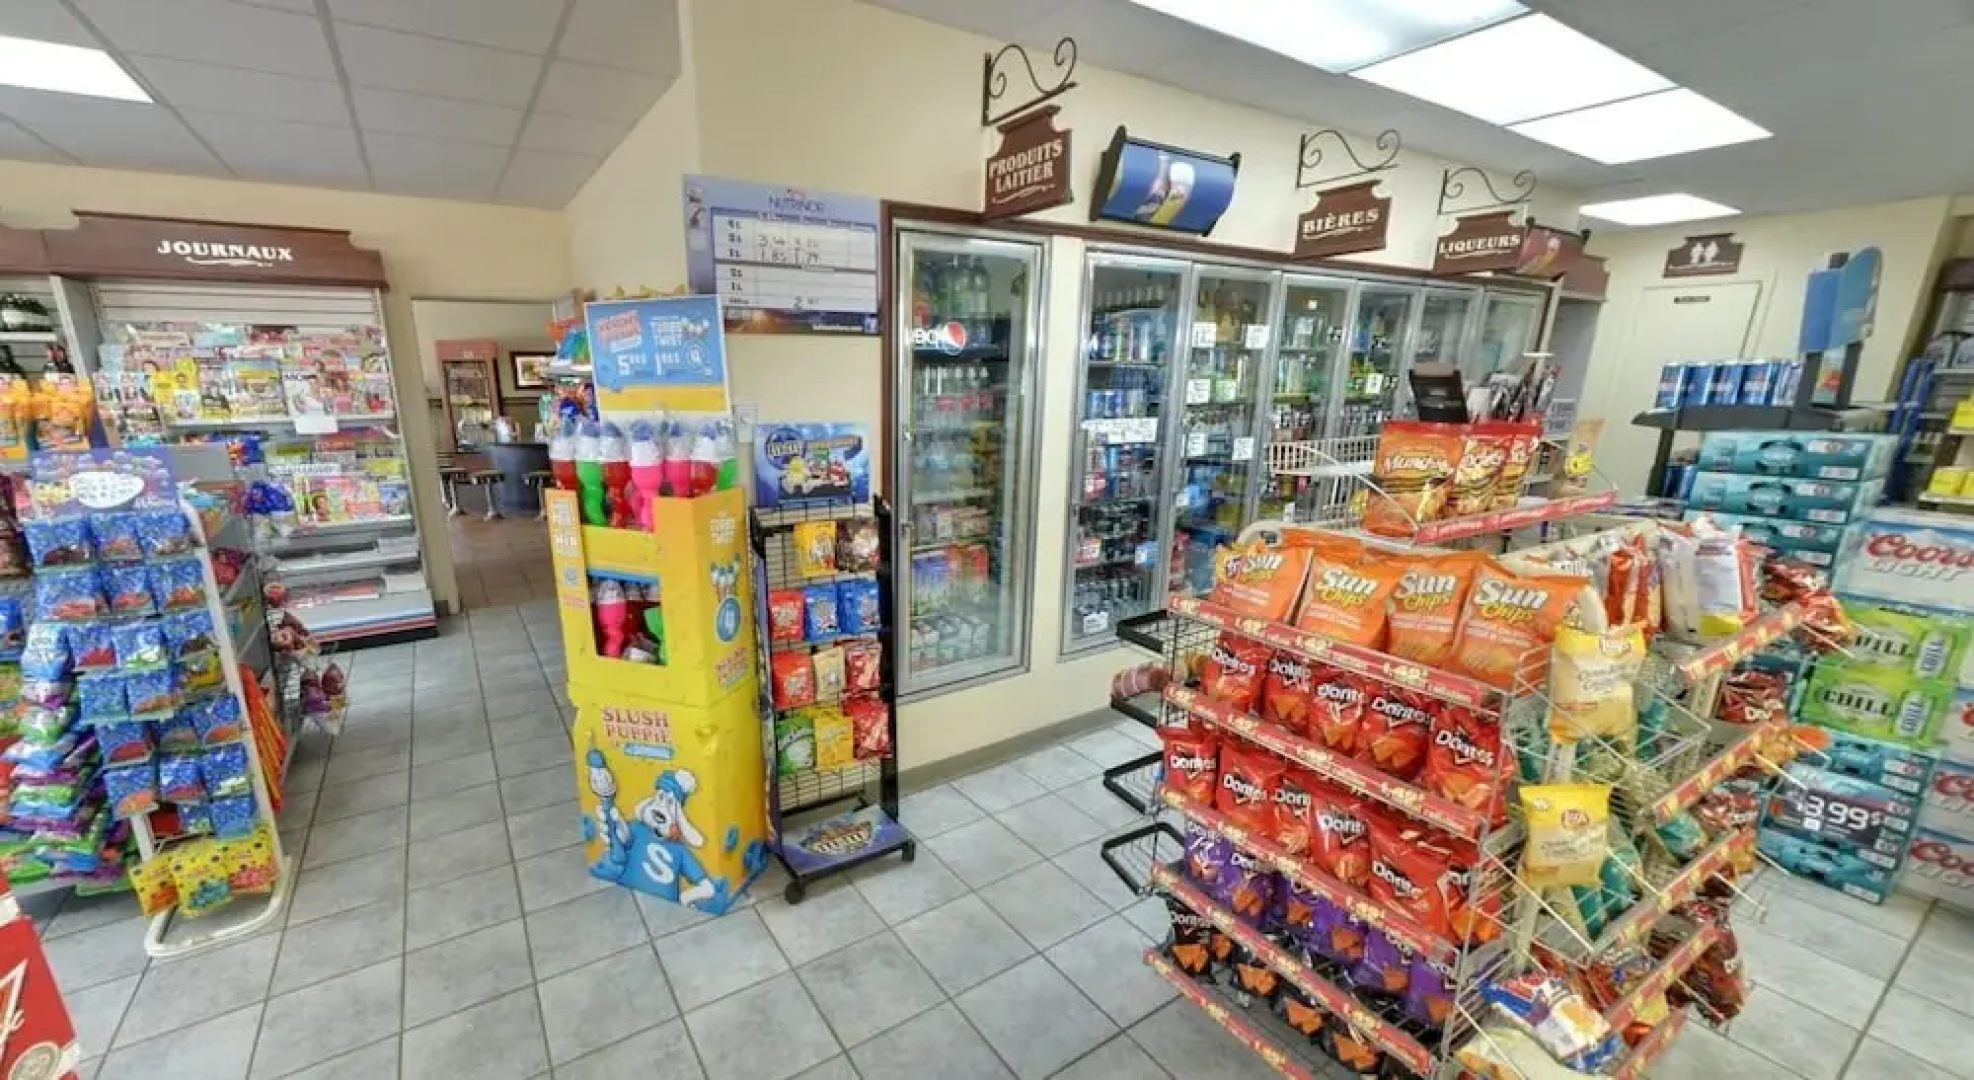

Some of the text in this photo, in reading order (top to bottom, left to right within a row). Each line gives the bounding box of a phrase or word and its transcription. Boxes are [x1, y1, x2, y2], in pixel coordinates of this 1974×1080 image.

[988, 138, 1063, 180] PRODUITS
[994, 160, 1054, 193] LAITIER
[1301, 207, 1380, 234] BIÈRES
[157, 239, 293, 262] JOURNAUX
[1438, 233, 1521, 255] LIQUEURS
[1315, 566, 1379, 595] Sun
[1394, 571, 1457, 598] Sun
[1474, 577, 1549, 609] Sun
[1482, 601, 1537, 624] Chips
[1852, 633, 1912, 656] HILL
[1823, 687, 1895, 718] CHILL
[602, 706, 669, 728] SLUSH
[605, 723, 670, 744] PUPPIE
[1435, 730, 1494, 766] Doritos
